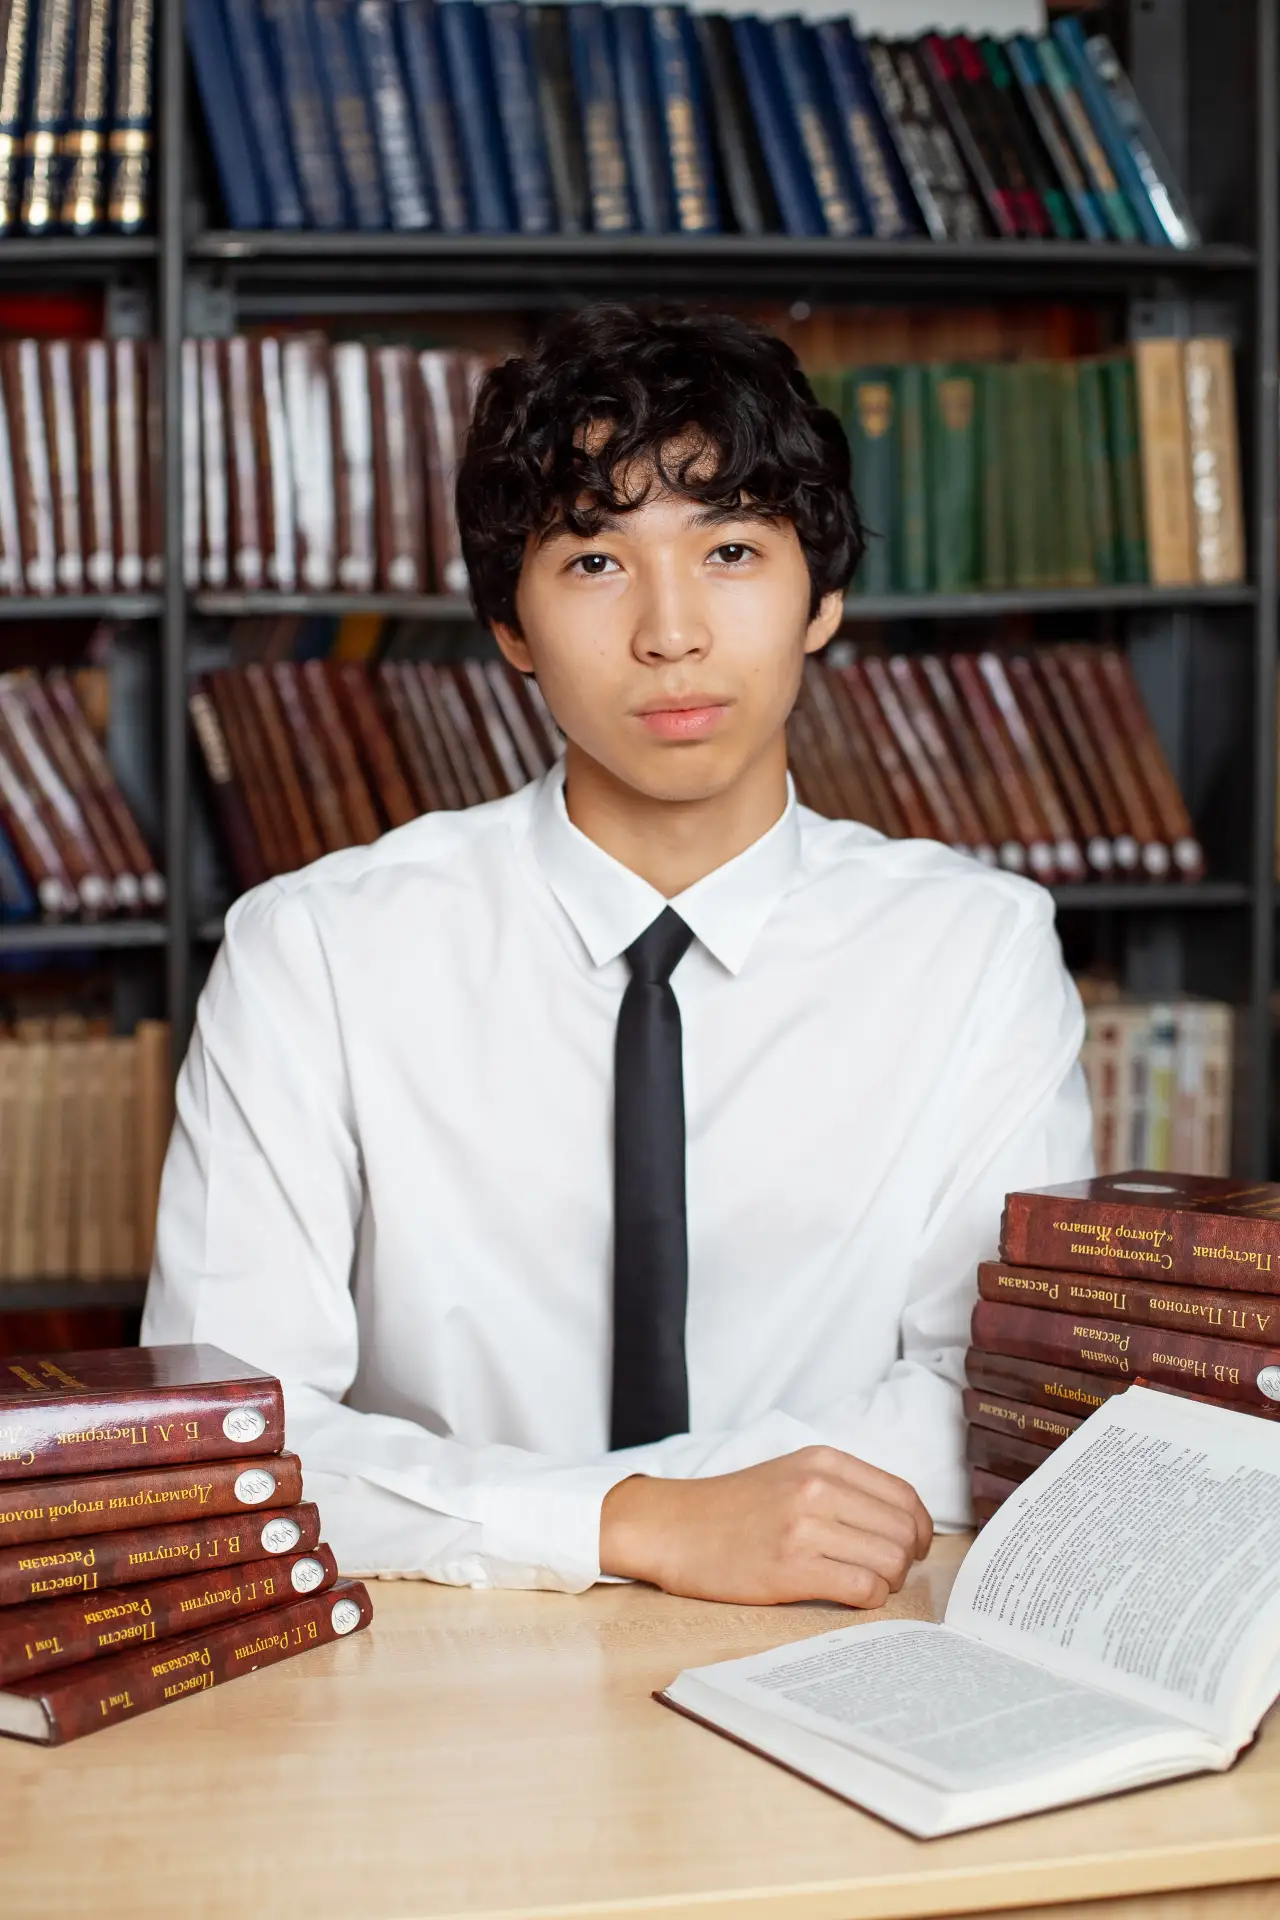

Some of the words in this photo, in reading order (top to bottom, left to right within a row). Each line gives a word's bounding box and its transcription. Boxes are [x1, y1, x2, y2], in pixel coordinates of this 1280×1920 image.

[1052, 1220, 1113, 1242] Живаго»
[1114, 1224, 1173, 1248] «Доктор
[1070, 1243, 1173, 1269] Стихотворения
[1192, 1245, 1272, 1271] Пастернак
[998, 1276, 1059, 1299] Рассказы
[1069, 1286, 1126, 1309] Повести
[1148, 1298, 1222, 1325] Платонов
[1227, 1309, 1246, 1328] П.
[1250, 1311, 1270, 1331] А.
[1072, 1326, 1130, 1351] Рассказы
[1080, 1349, 1129, 1372] Романы
[1151, 1352, 1208, 1376] Набоков
[1210, 1365, 1240, 1384] В.В.
[978, 1402, 1026, 1429] Рассказы
[56, 1426, 148, 1445] Пастернак
[153, 1424, 175, 1442] Л.
[179, 1421, 199, 1439] Б.
[108, 1483, 213, 1510] Драматургия
[48, 1500, 104, 1523] второй
[128, 1542, 201, 1566] Распутин
[204, 1539, 219, 1557] Г.
[222, 1535, 240, 1553] В.
[18, 1548, 95, 1573] Рассказы
[30, 1572, 98, 1594] Повести
[244, 1582, 257, 1600] Г.
[259, 1578, 275, 1595] В.
[179, 1585, 242, 1614] Распутин
[83, 1598, 152, 1626] Рассказы
[97, 1621, 156, 1646] Повести
[290, 1626, 302, 1642] Г.
[304, 1621, 318, 1639] В.
[24, 1642, 33, 1660] 1
[35, 1636, 64, 1656] Том
[234, 1632, 289, 1662] Распутин
[151, 1646, 211, 1679] Рассказы
[163, 1670, 215, 1700] Повести
[98, 1697, 108, 1716] 1
[108, 1689, 134, 1710] Том
